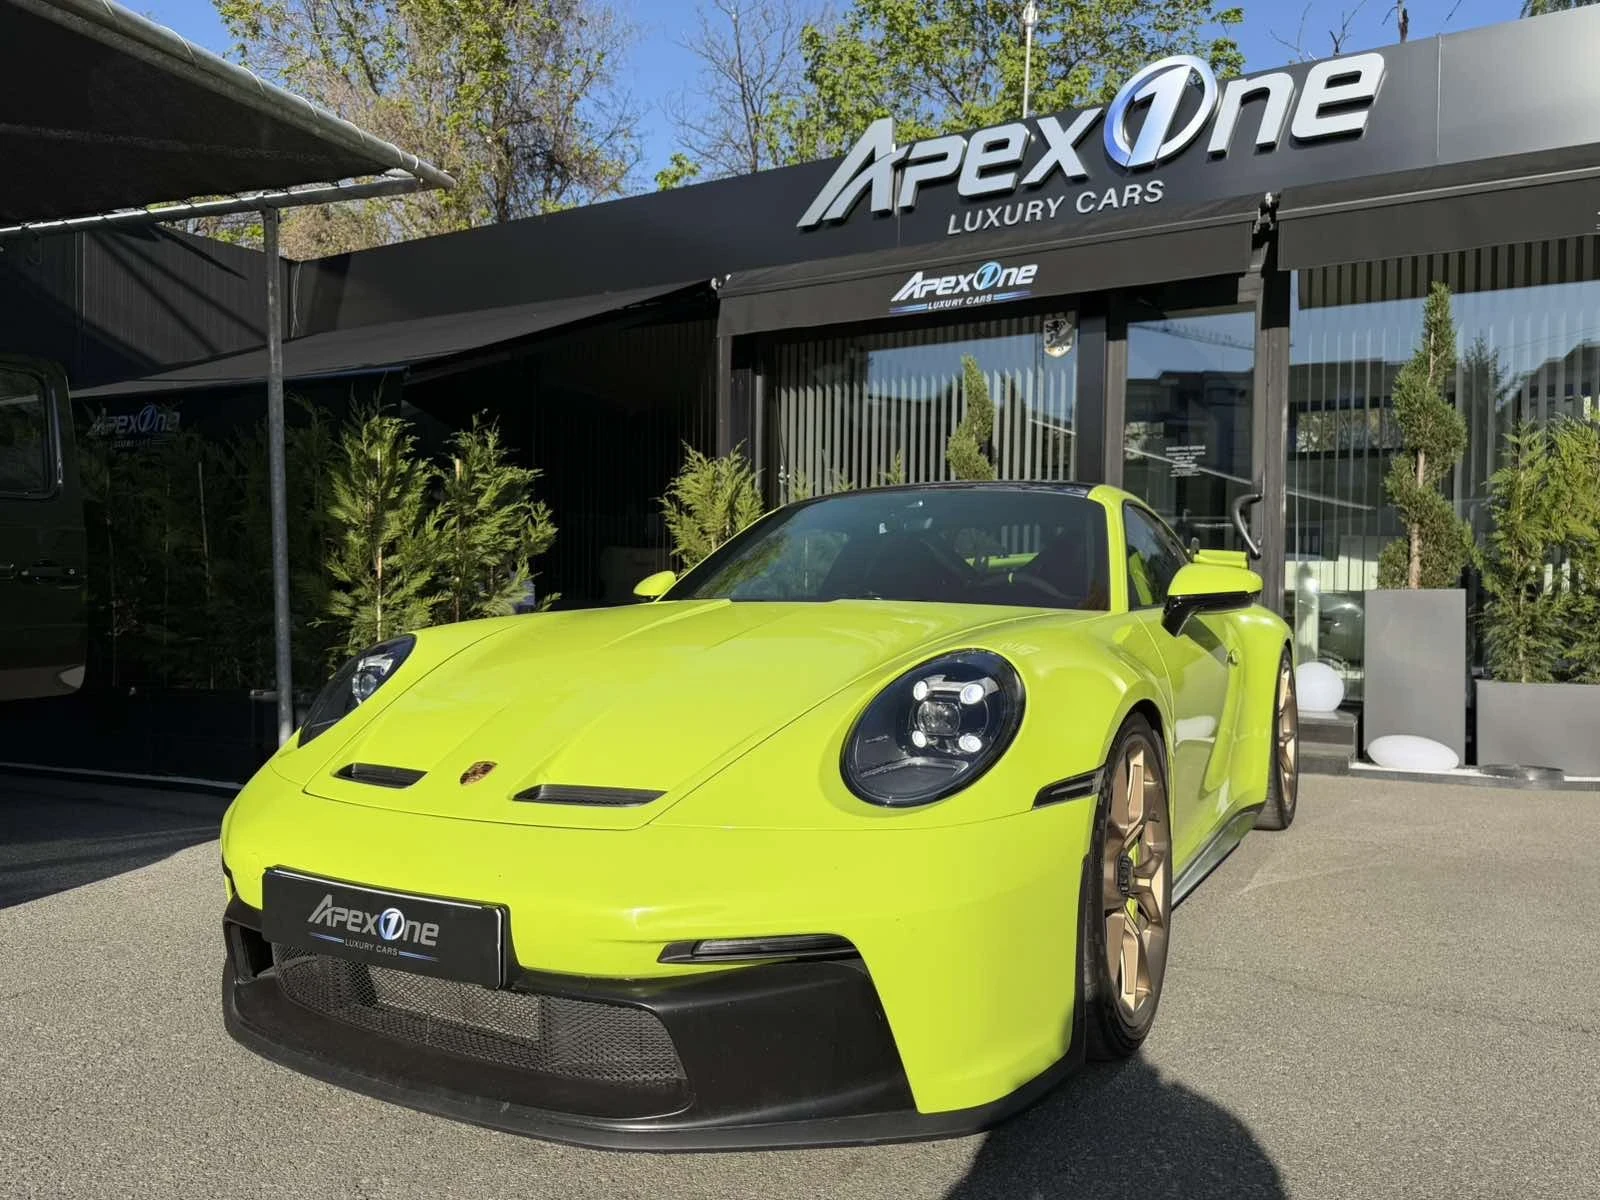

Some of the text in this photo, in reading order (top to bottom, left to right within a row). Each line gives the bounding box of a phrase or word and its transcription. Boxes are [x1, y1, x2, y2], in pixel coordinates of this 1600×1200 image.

[947, 180, 1164, 235] LUXURY CARS
[928, 294, 993, 310] LUXURY CARS
[344, 940, 398, 957] LUXURY CARS
